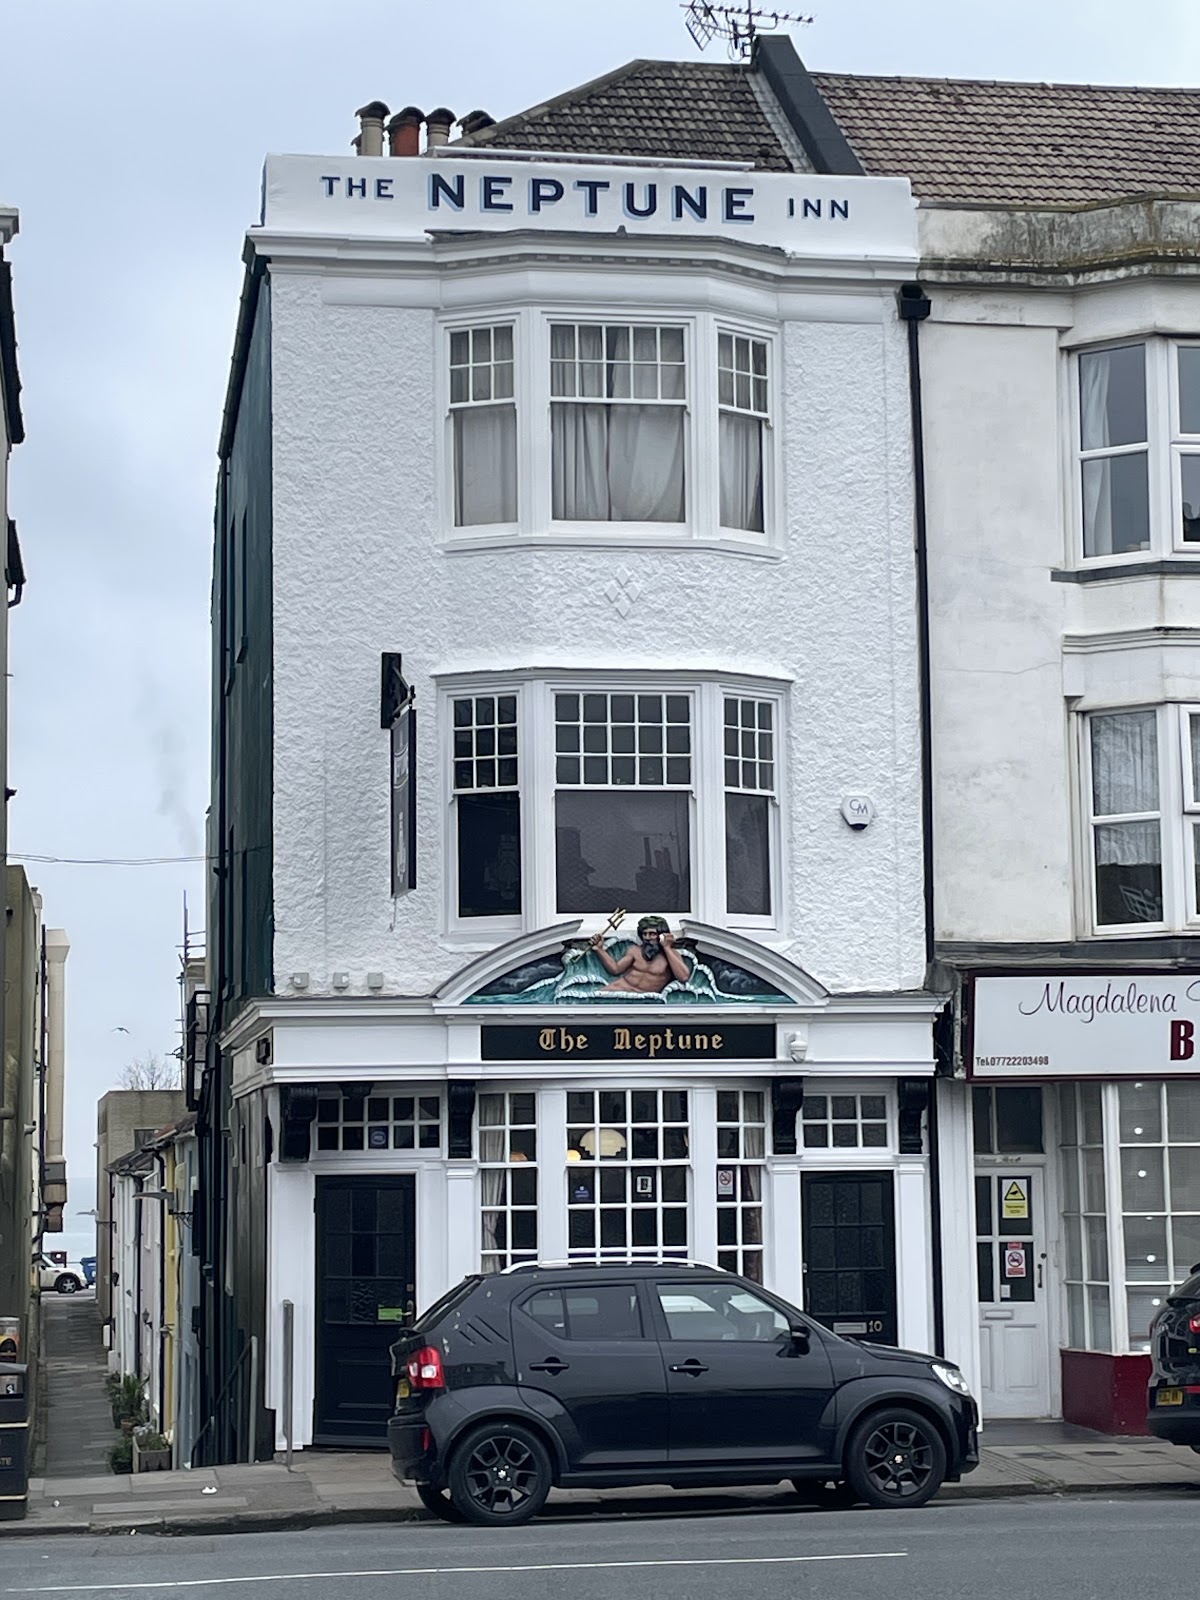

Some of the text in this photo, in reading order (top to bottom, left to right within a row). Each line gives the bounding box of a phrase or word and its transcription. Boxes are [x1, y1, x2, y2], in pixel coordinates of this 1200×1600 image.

[320, 173, 849, 223] THE NEPTUNE INN
[1018, 981, 1178, 1024] Magdalena
[538, 1027, 725, 1058] The Neptune
[868, 1320, 883, 1332] 10
